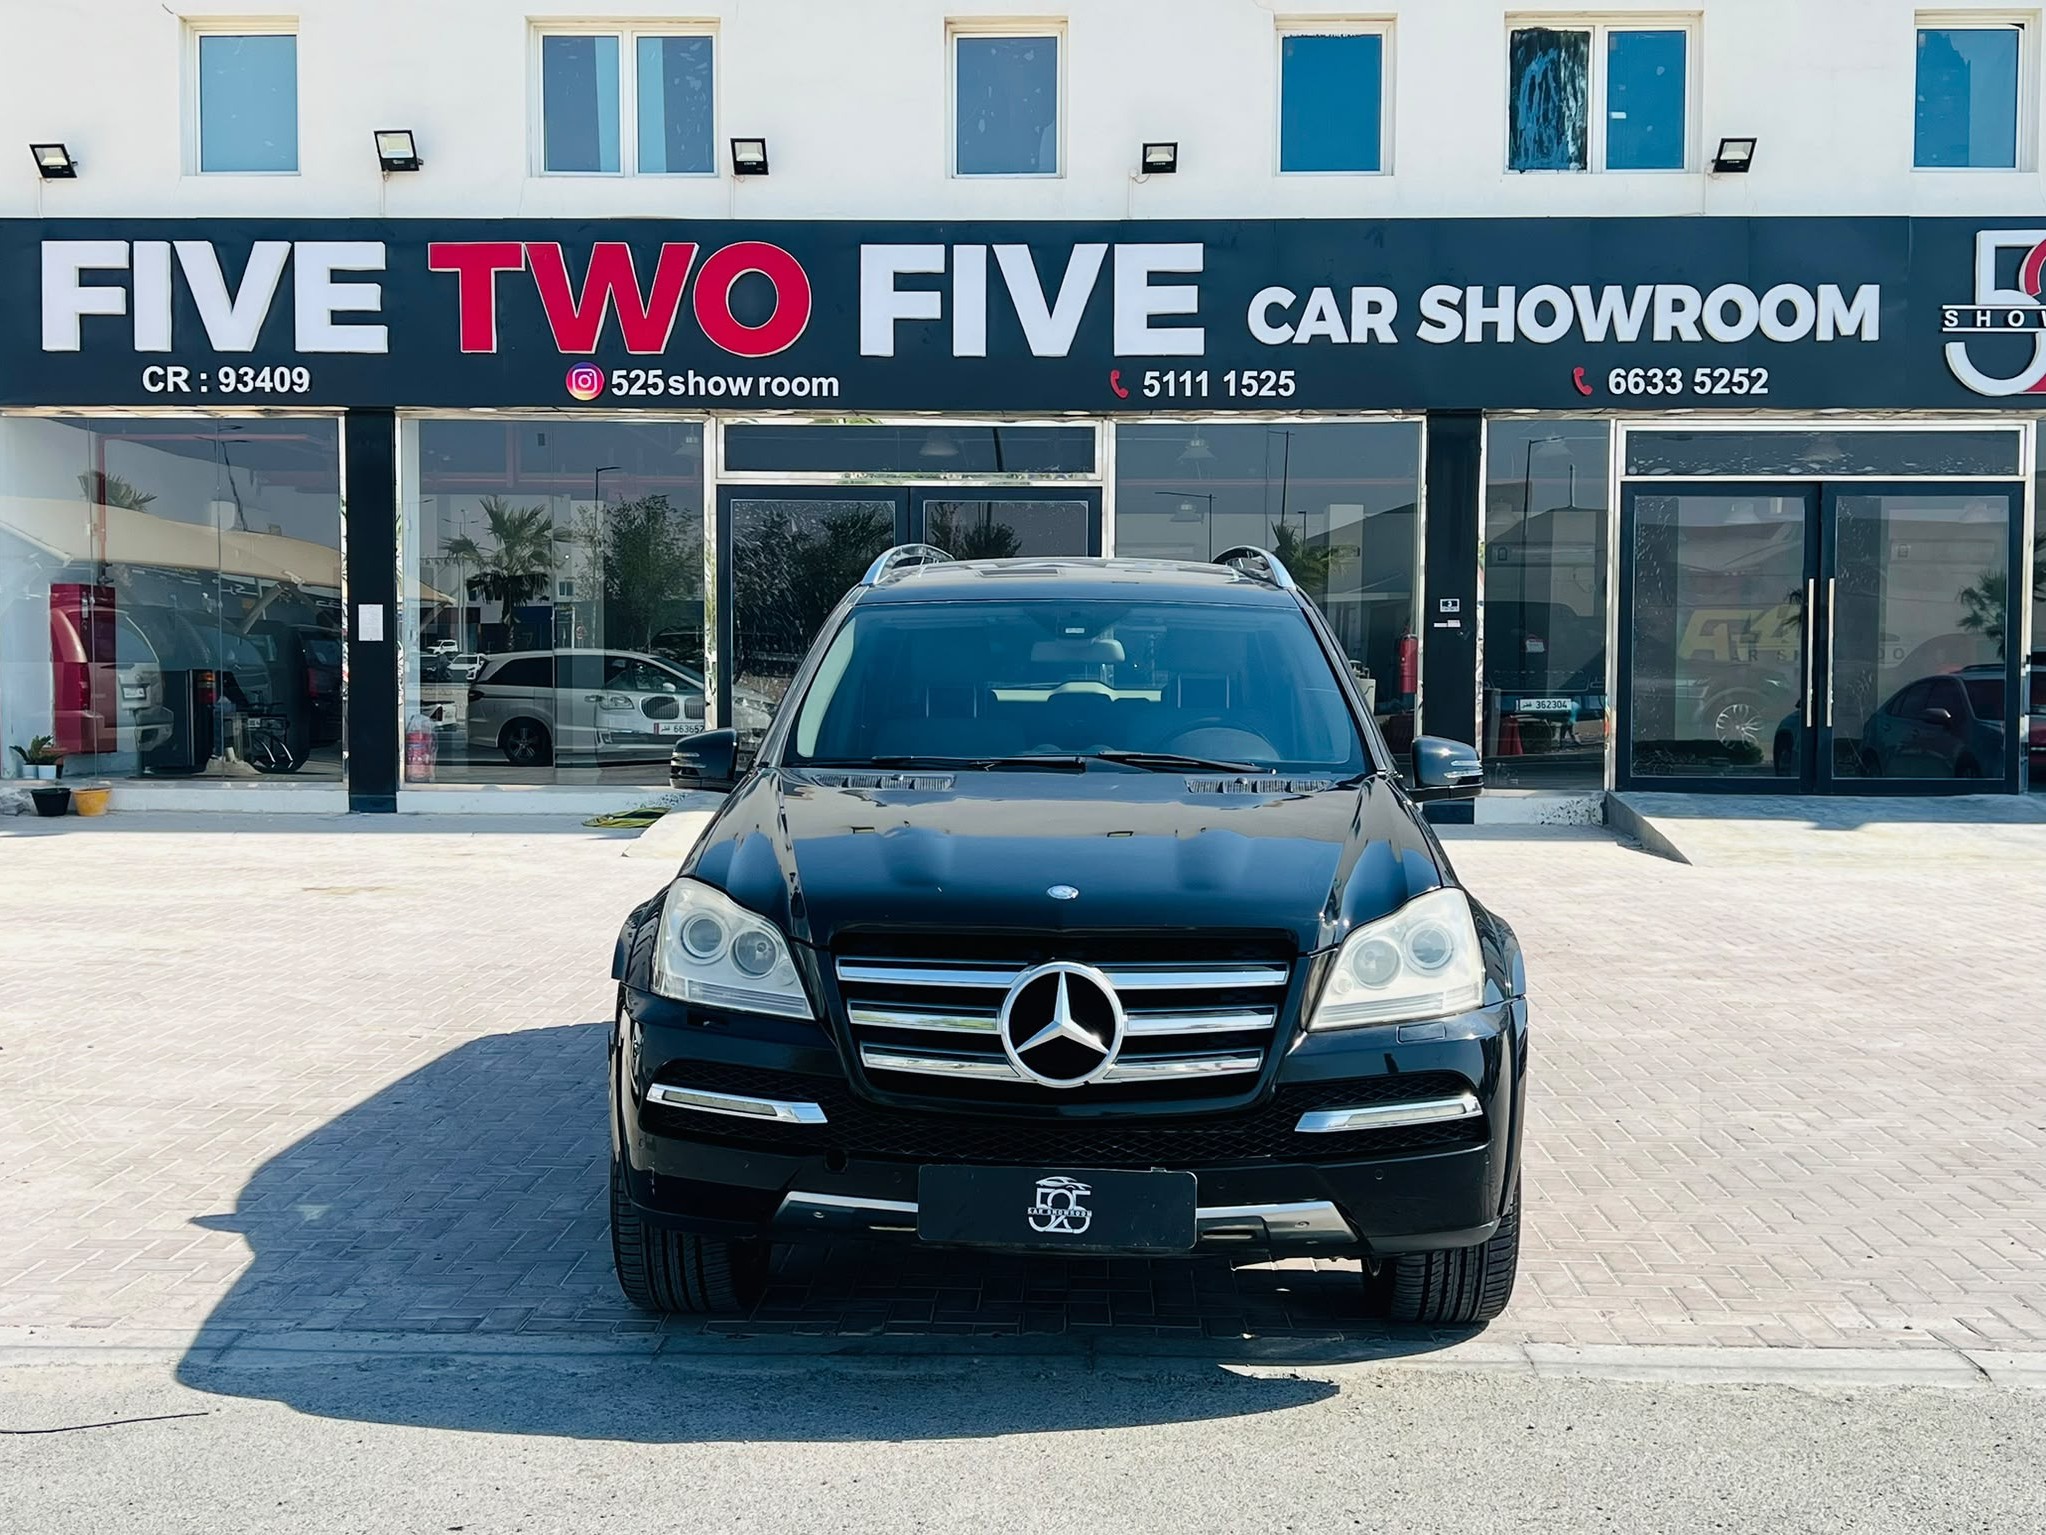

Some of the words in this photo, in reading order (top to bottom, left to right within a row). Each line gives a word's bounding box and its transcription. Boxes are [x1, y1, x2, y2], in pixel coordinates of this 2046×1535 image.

[41, 240, 389, 353] FIVE
[428, 241, 812, 357] TWO
[859, 243, 1205, 357] FIVE
[1247, 285, 1398, 344] CAR
[1416, 284, 1881, 344] SHOWROOM
[1944, 310, 2046, 328] SHO
[142, 366, 192, 393] CR
[218, 366, 311, 393] 93409
[1143, 370, 1209, 397] 5111
[1223, 370, 1296, 397] 1525
[1608, 367, 1683, 395] 6633
[1693, 367, 1769, 395] 5252
[1535, 700, 1568, 709] 362304
